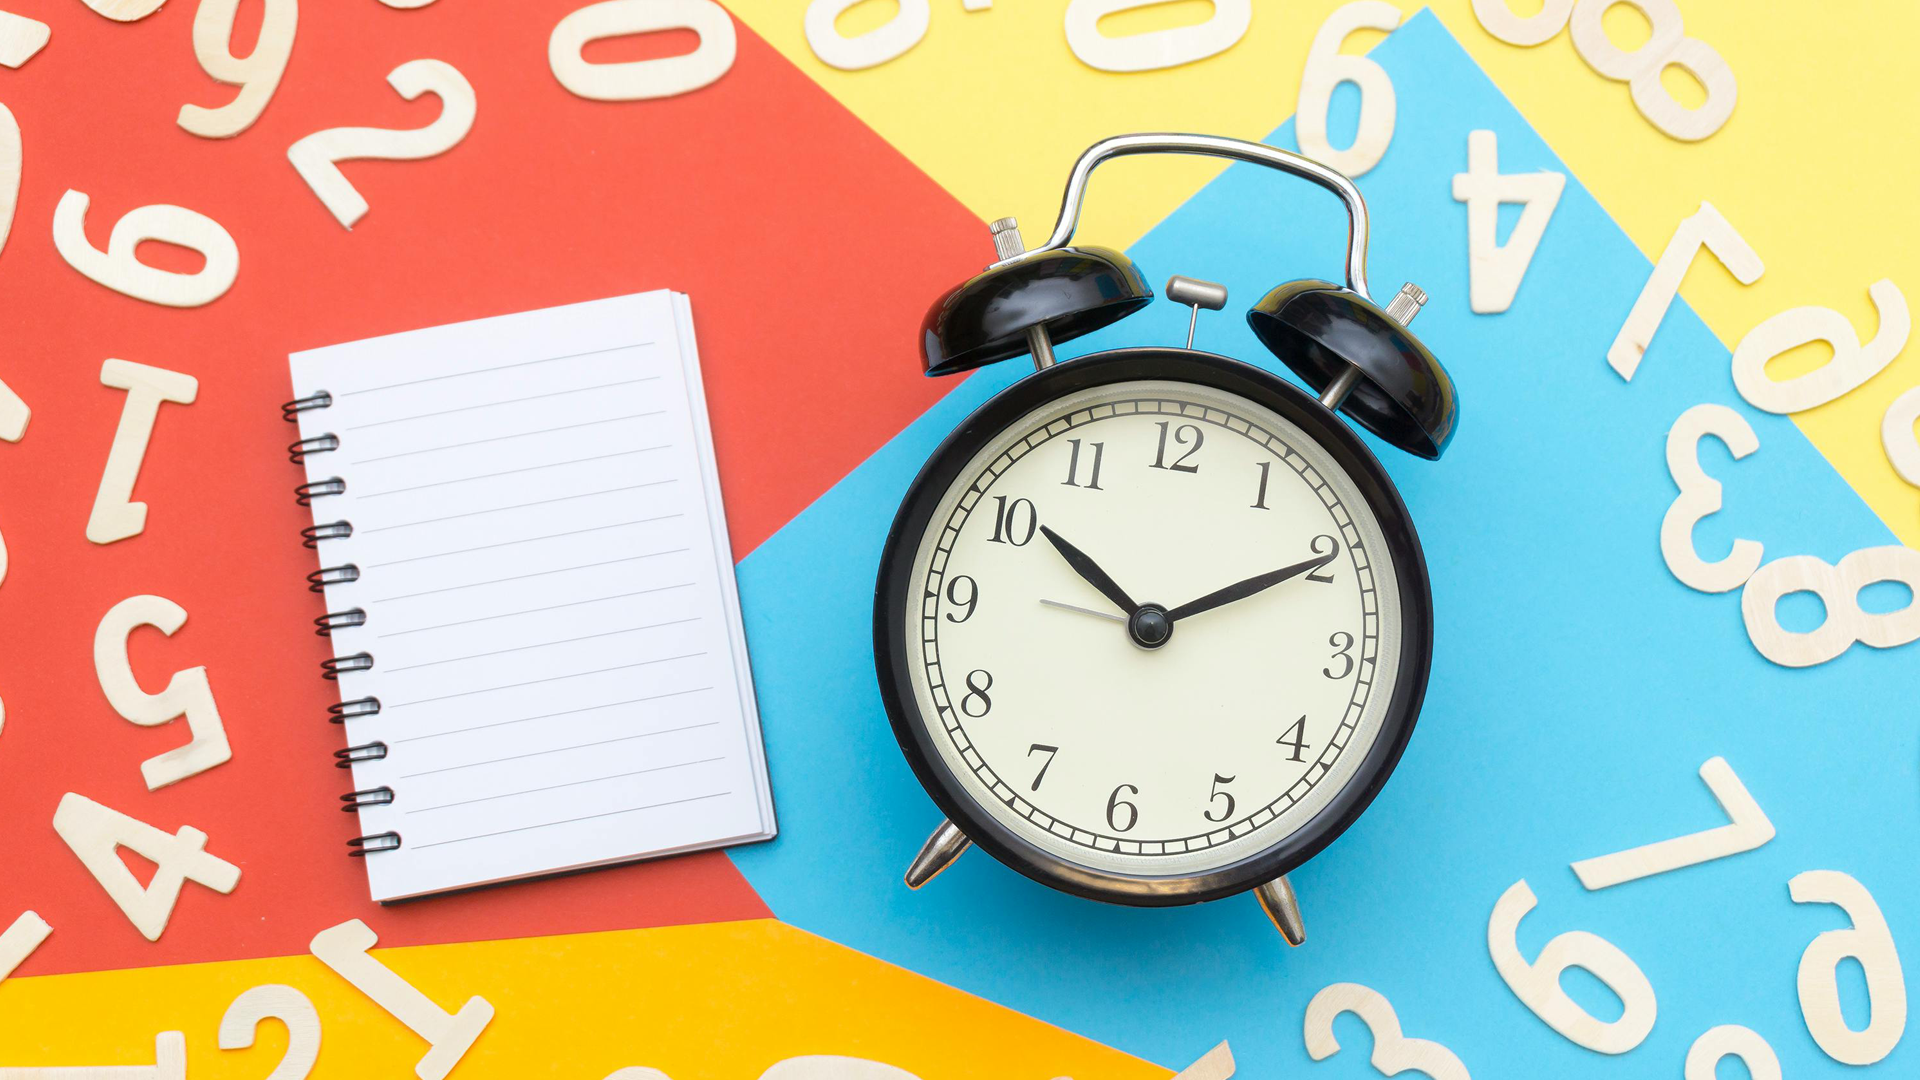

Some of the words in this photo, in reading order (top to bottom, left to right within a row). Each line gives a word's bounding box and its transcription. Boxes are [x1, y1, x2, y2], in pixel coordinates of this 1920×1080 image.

[1295, 0, 1403, 178] 6
[1569, 0, 1738, 142] 8
[287, 58, 477, 230] 2
[1452, 129, 1567, 314] 4
[86, 358, 199, 542] 1
[1060, 438, 1105, 491] 11
[1148, 421, 1205, 474] 12
[1249, 461, 1272, 511] 1
[986, 495, 1038, 547] 10
[1305, 534, 1341, 584] 2
[945, 575, 979, 624] 9
[1741, 545, 1920, 667] 8
[1322, 631, 1355, 680] 3
[94, 595, 232, 790] 5
[960, 669, 994, 718] 8
[1275, 714, 1311, 764] 4
[1027, 742, 1059, 791] 7
[1106, 783, 1139, 833] 6
[1203, 772, 1237, 823] 5
[1570, 756, 1776, 891] 7
[53, 792, 242, 941] 4
